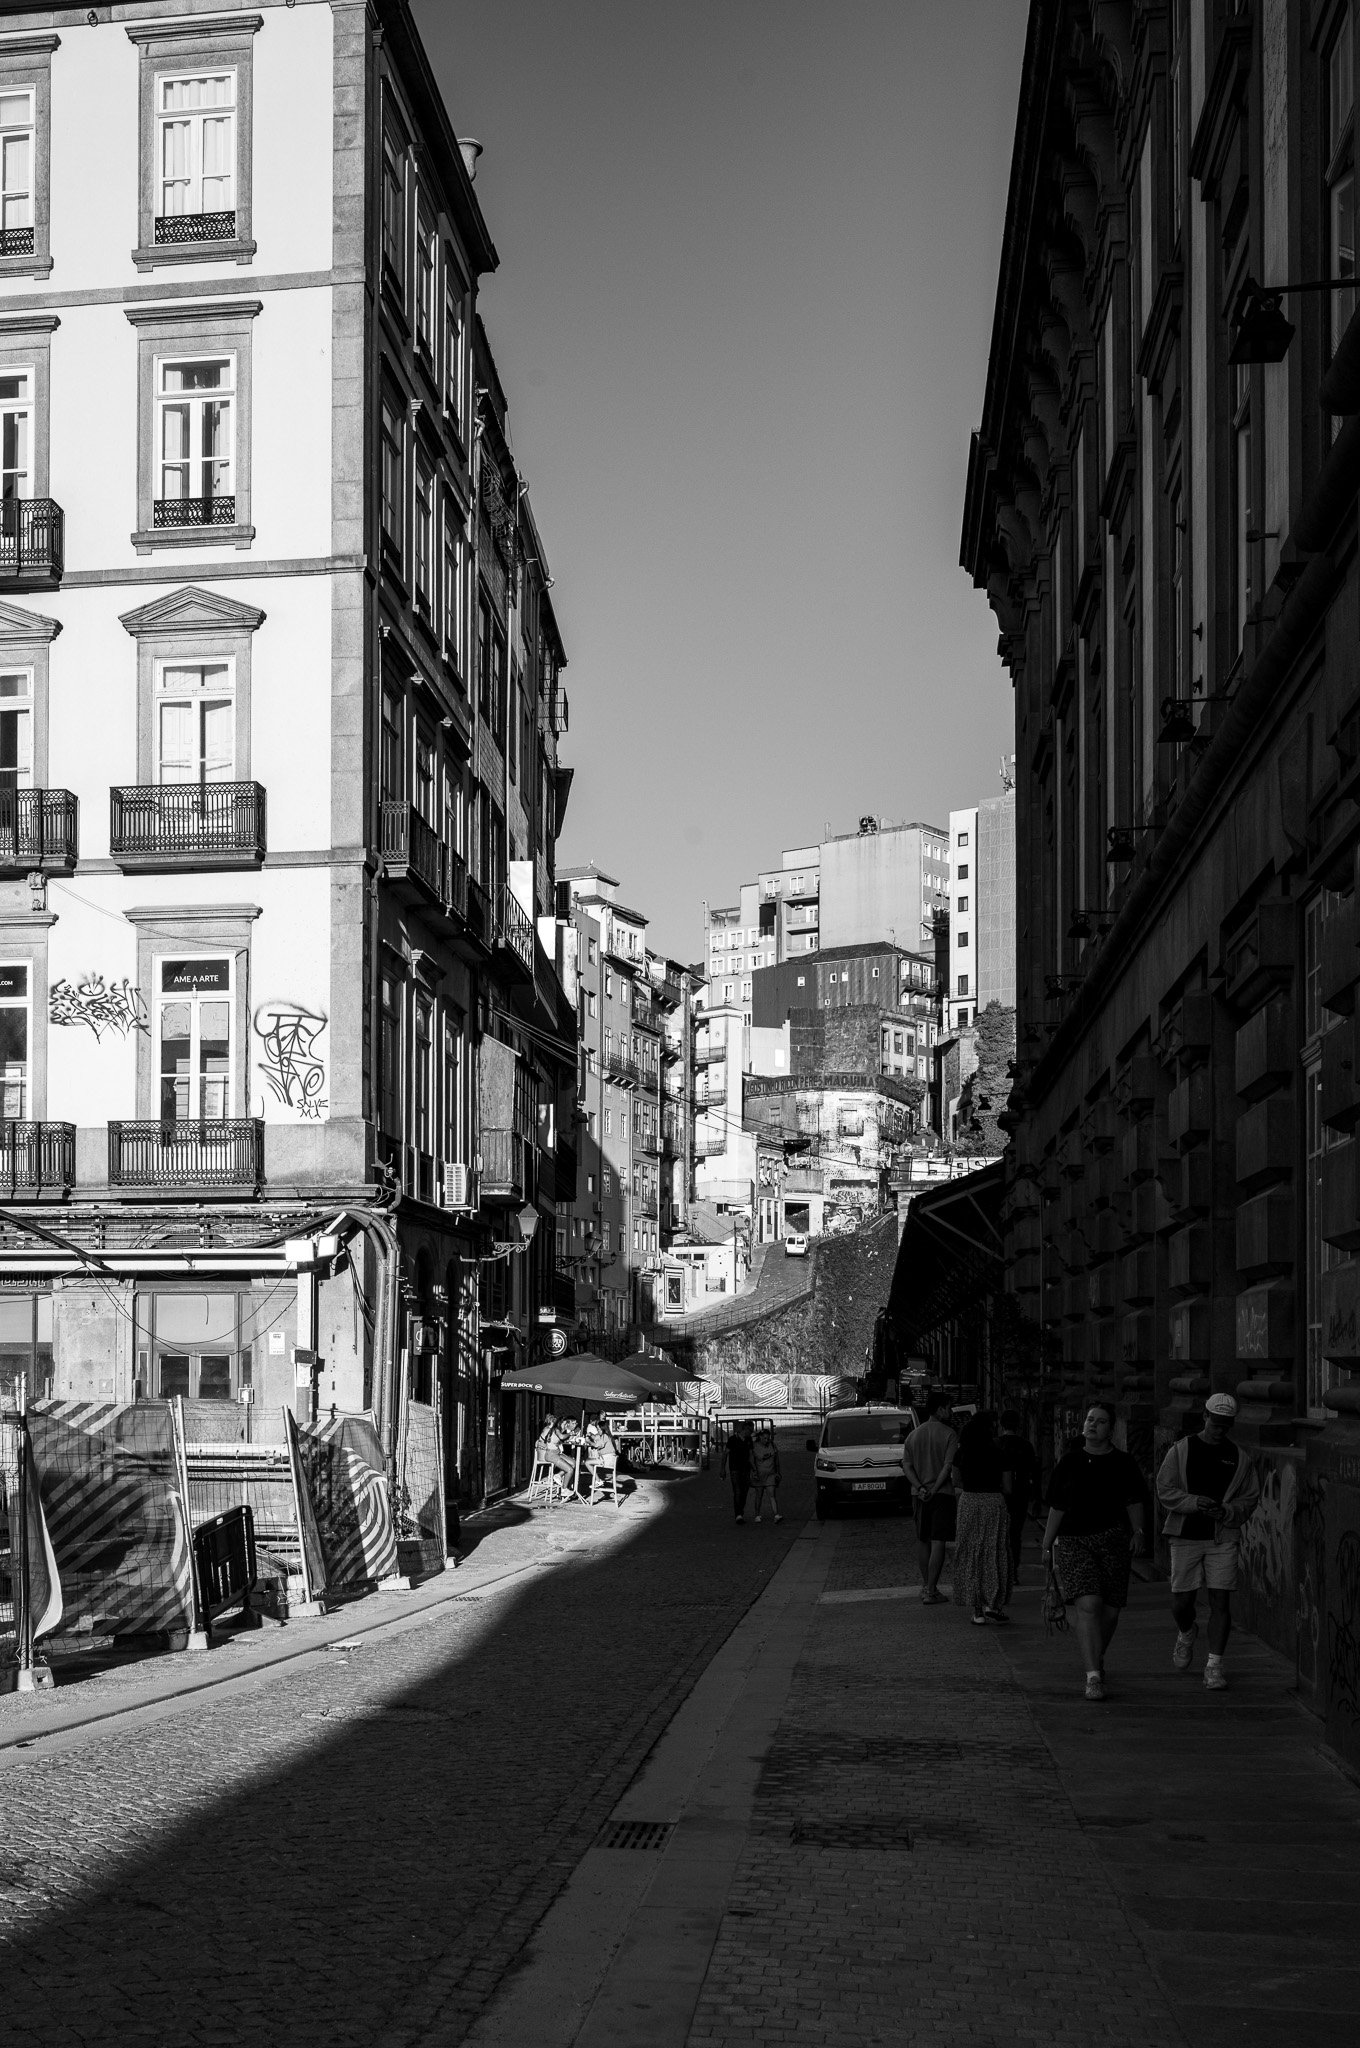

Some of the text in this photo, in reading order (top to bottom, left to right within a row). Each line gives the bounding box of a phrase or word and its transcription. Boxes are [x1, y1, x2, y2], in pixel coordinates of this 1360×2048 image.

[173, 974, 219, 983] AME A ARTE
